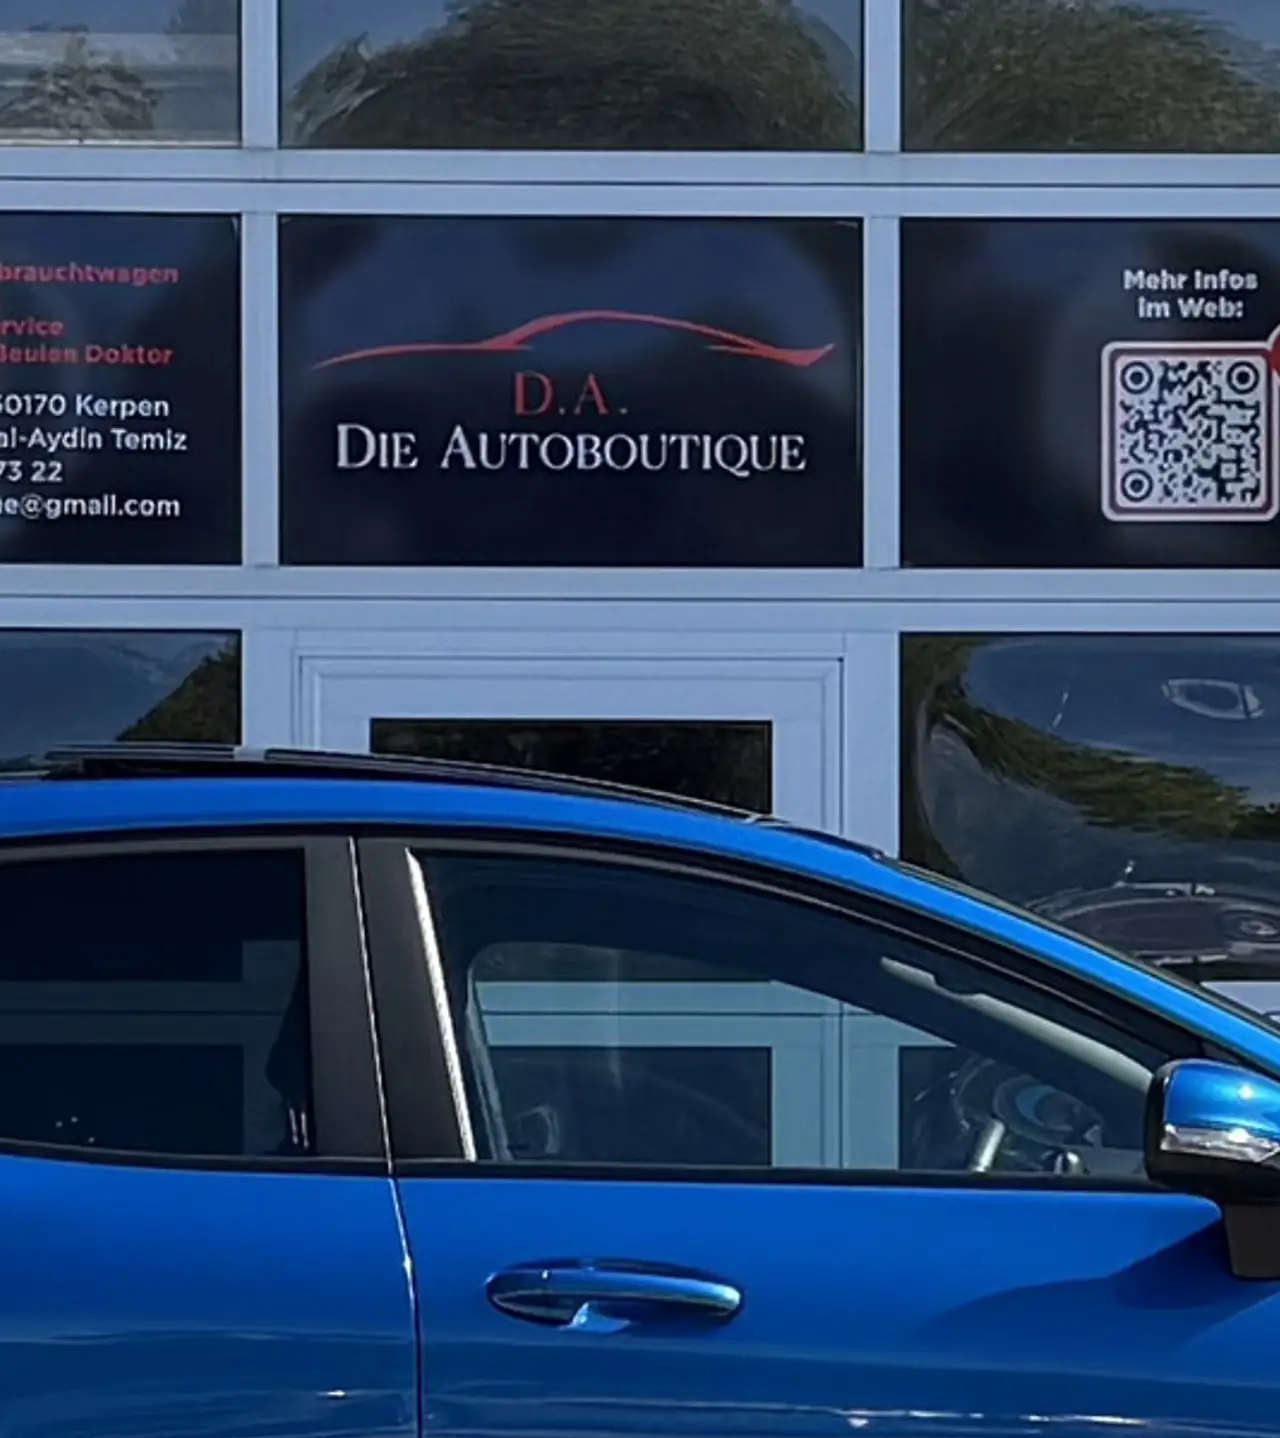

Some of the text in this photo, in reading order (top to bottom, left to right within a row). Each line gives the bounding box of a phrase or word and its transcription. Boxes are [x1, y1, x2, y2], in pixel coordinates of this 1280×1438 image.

[1123, 269, 1189, 290] Mehr
[1177, 296, 1245, 318] Web:
[85, 344, 174, 364] Doktor
[75, 394, 170, 420] Kerpen
[110, 427, 188, 451] Temiz
[31, 461, 64, 482] 22
